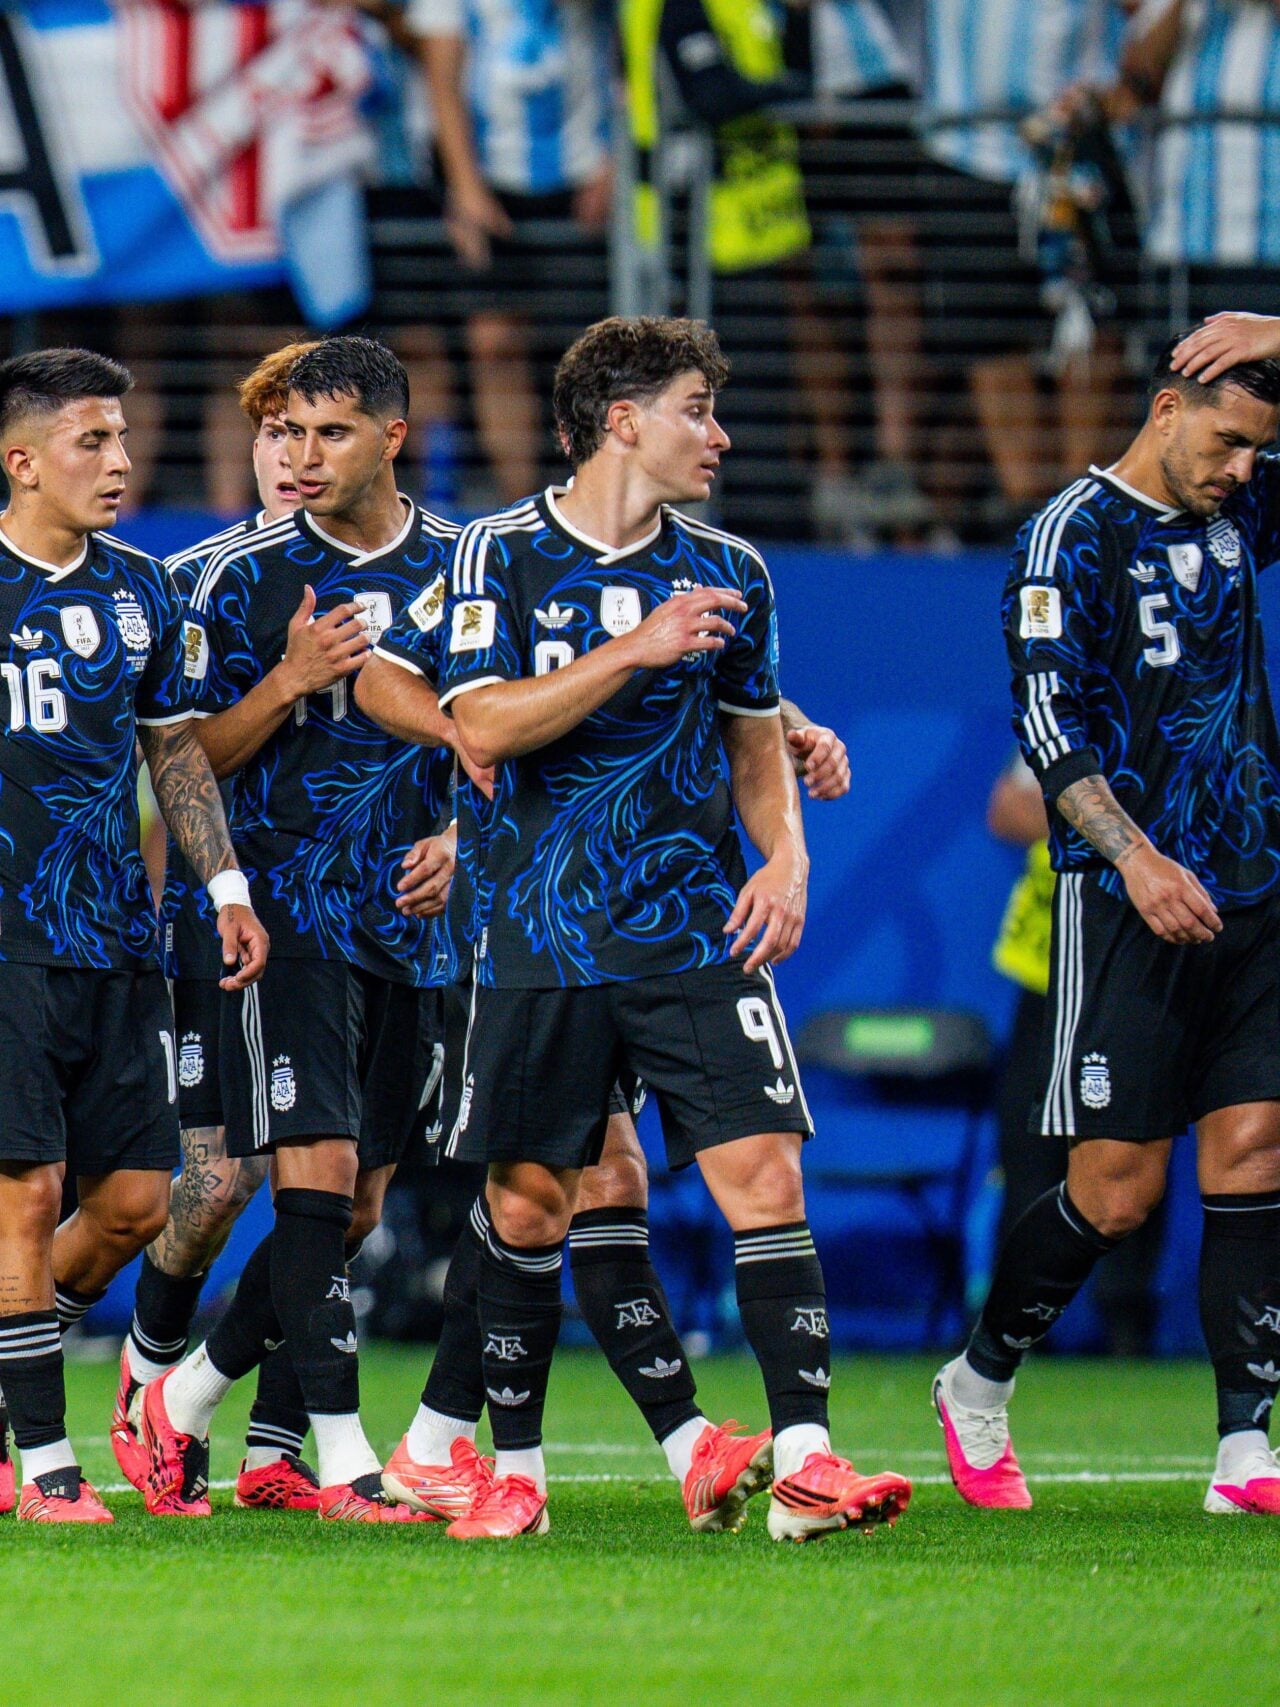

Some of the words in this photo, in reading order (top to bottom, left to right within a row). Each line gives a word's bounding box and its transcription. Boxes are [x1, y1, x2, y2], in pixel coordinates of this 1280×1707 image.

[126, 615, 144, 636] AFA
[1138, 593, 1181, 668] 5
[76, 637, 92, 645] FIFA
[0, 658, 68, 733] 16
[736, 996, 784, 1069] 9
[159, 1030, 177, 1105] 1
[182, 1056, 196, 1074] AFA
[275, 1079, 290, 1098] AFA
[1087, 1077, 1104, 1096] AFA
[325, 1275, 352, 1302] AF
[616, 1298, 660, 1330] AFA
[790, 1307, 829, 1338] AFA
[483, 1332, 528, 1361] AFA
